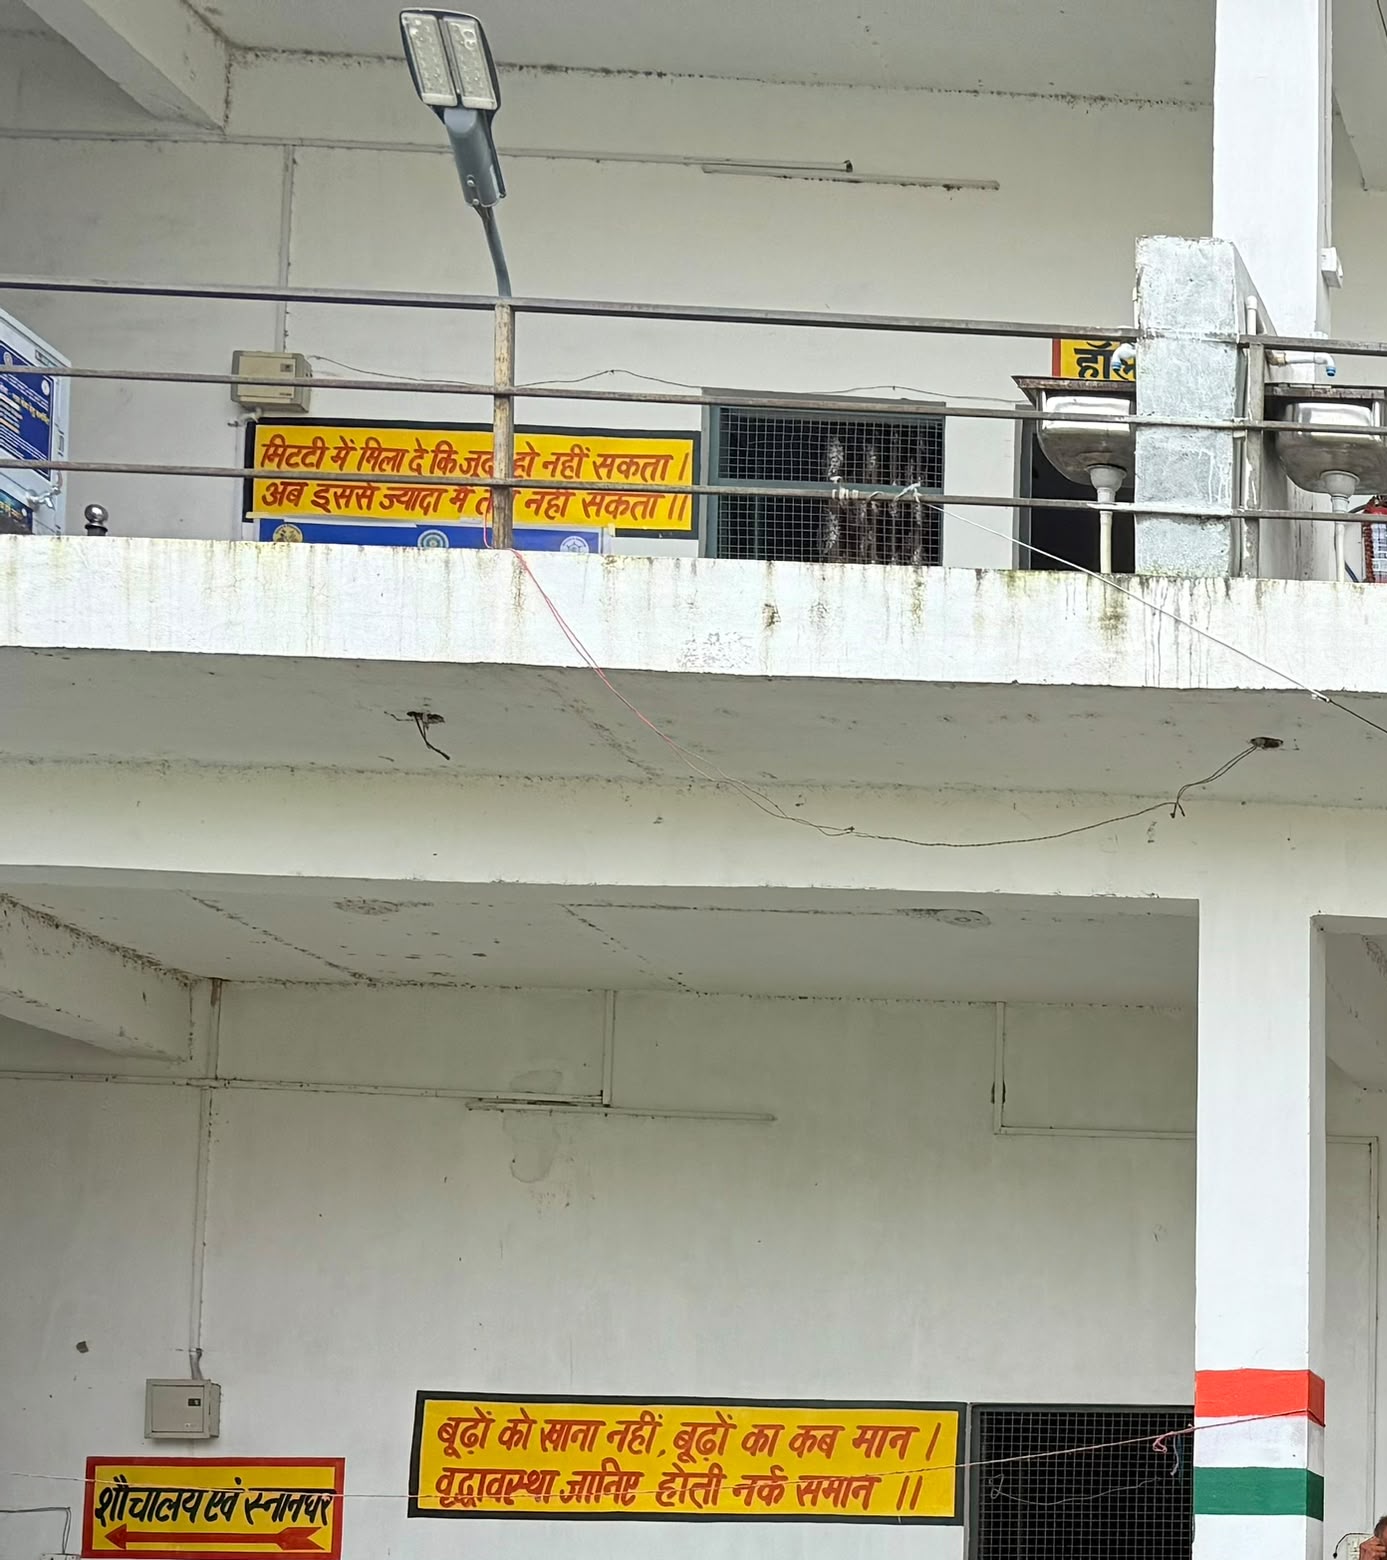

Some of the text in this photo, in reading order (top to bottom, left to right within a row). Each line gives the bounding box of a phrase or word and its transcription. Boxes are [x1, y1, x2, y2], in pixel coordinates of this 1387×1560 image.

[330, 435, 357, 471] में
[357, 436, 409, 473] मिला
[408, 437, 429, 475] दे
[429, 440, 458, 475] कि
[542, 443, 591, 479] नहीं
[592, 453, 674, 482] सकता
[261, 481, 308, 507] अब
[379, 487, 448, 516] ज्यादा
[582, 492, 666, 521] सकता
[498, 1407, 537, 1451] को
[741, 1424, 785, 1457] का
[789, 1425, 845, 1460] कब
[852, 1425, 920, 1460] मान
[95, 1474, 337, 1527] शौचालय एवं स्नानघर
[559, 1457, 644, 1507] जानिए
[656, 1462, 727, 1509] होती
[732, 1464, 788, 1506] नर्क
[796, 1475, 882, 1511] समान
